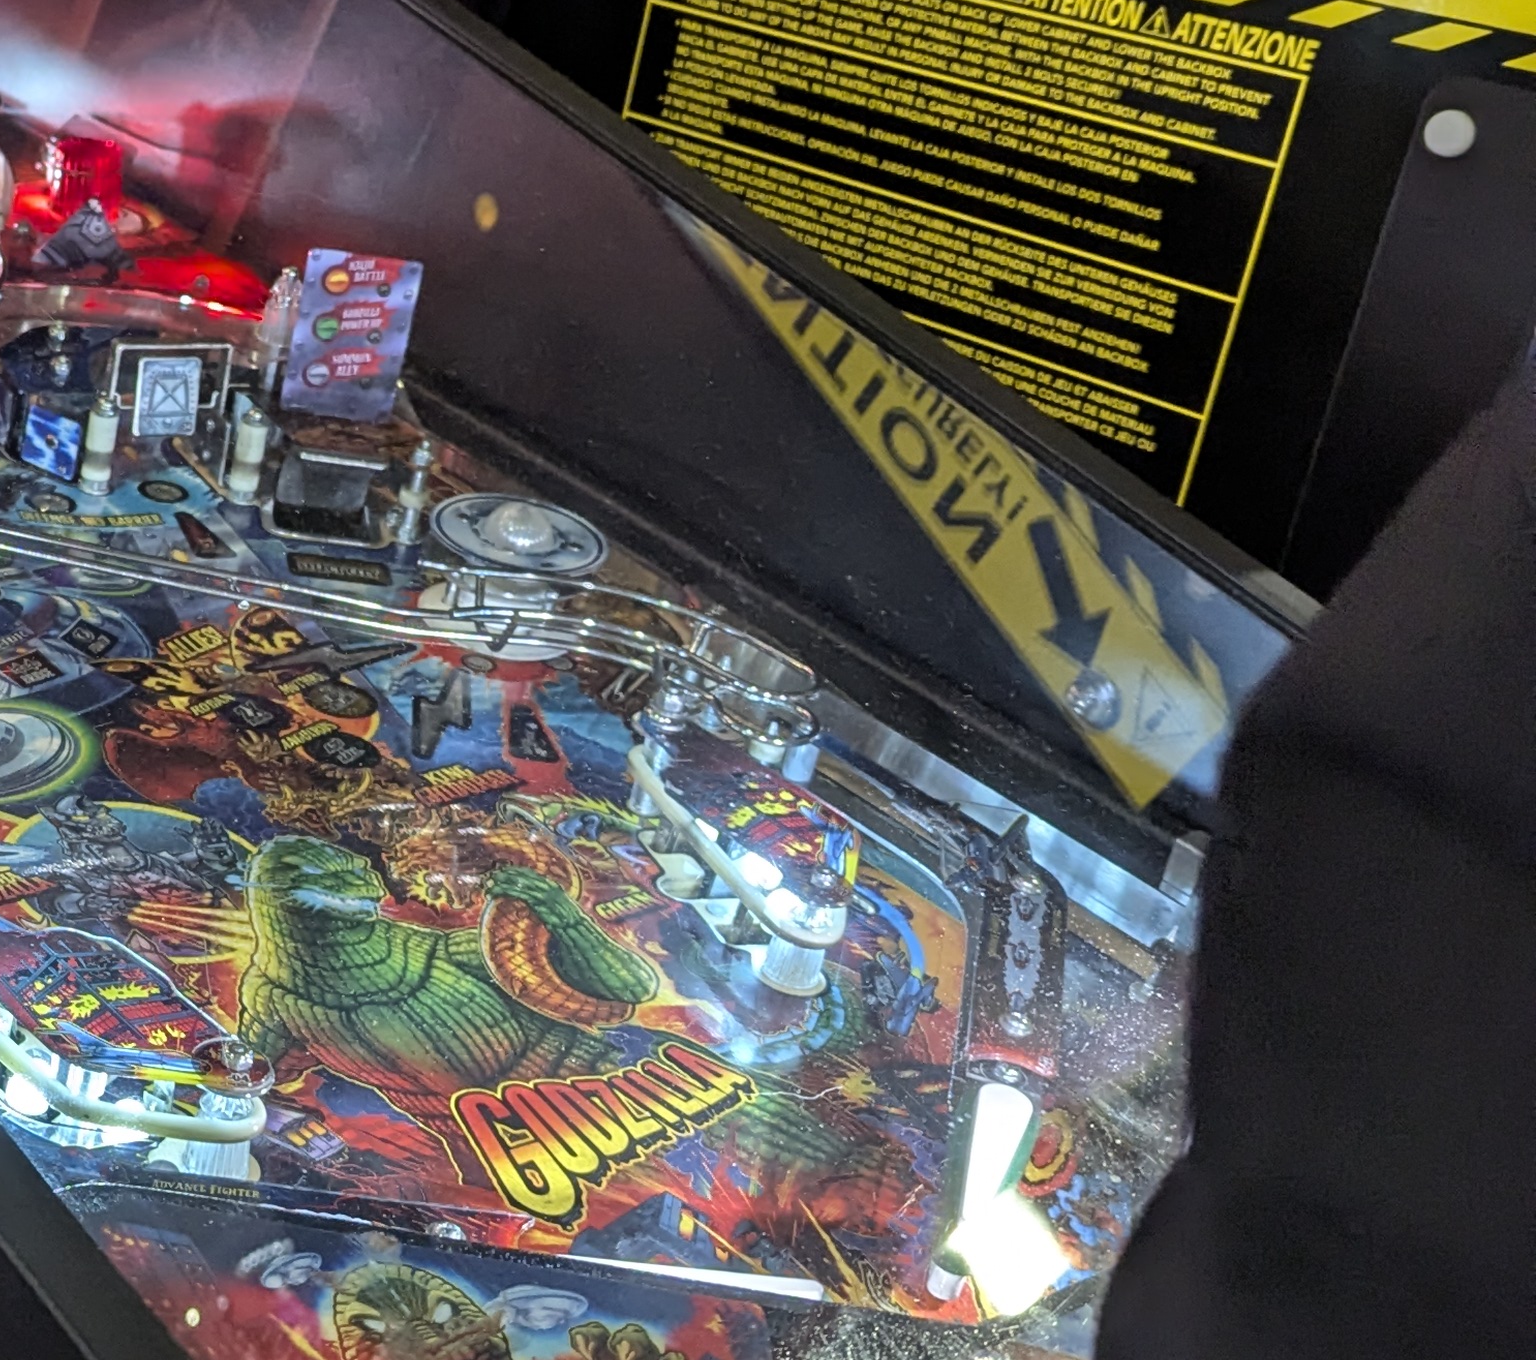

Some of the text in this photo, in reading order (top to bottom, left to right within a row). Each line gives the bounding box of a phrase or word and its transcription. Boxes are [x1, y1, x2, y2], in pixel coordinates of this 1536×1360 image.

[1172, 11, 1320, 71] ATTENZIONE
[1199, 78, 1217, 92] TO
[167, 625, 229, 662] ALLIES!
[190, 693, 236, 717] RODAN
[414, 768, 524, 806] GHIDORAH
[422, 764, 474, 786] KING
[594, 891, 657, 920] GIGAN
[451, 1042, 757, 1234] GODZILLA
[151, 1178, 261, 1199] ADVANCE FIGHTER
